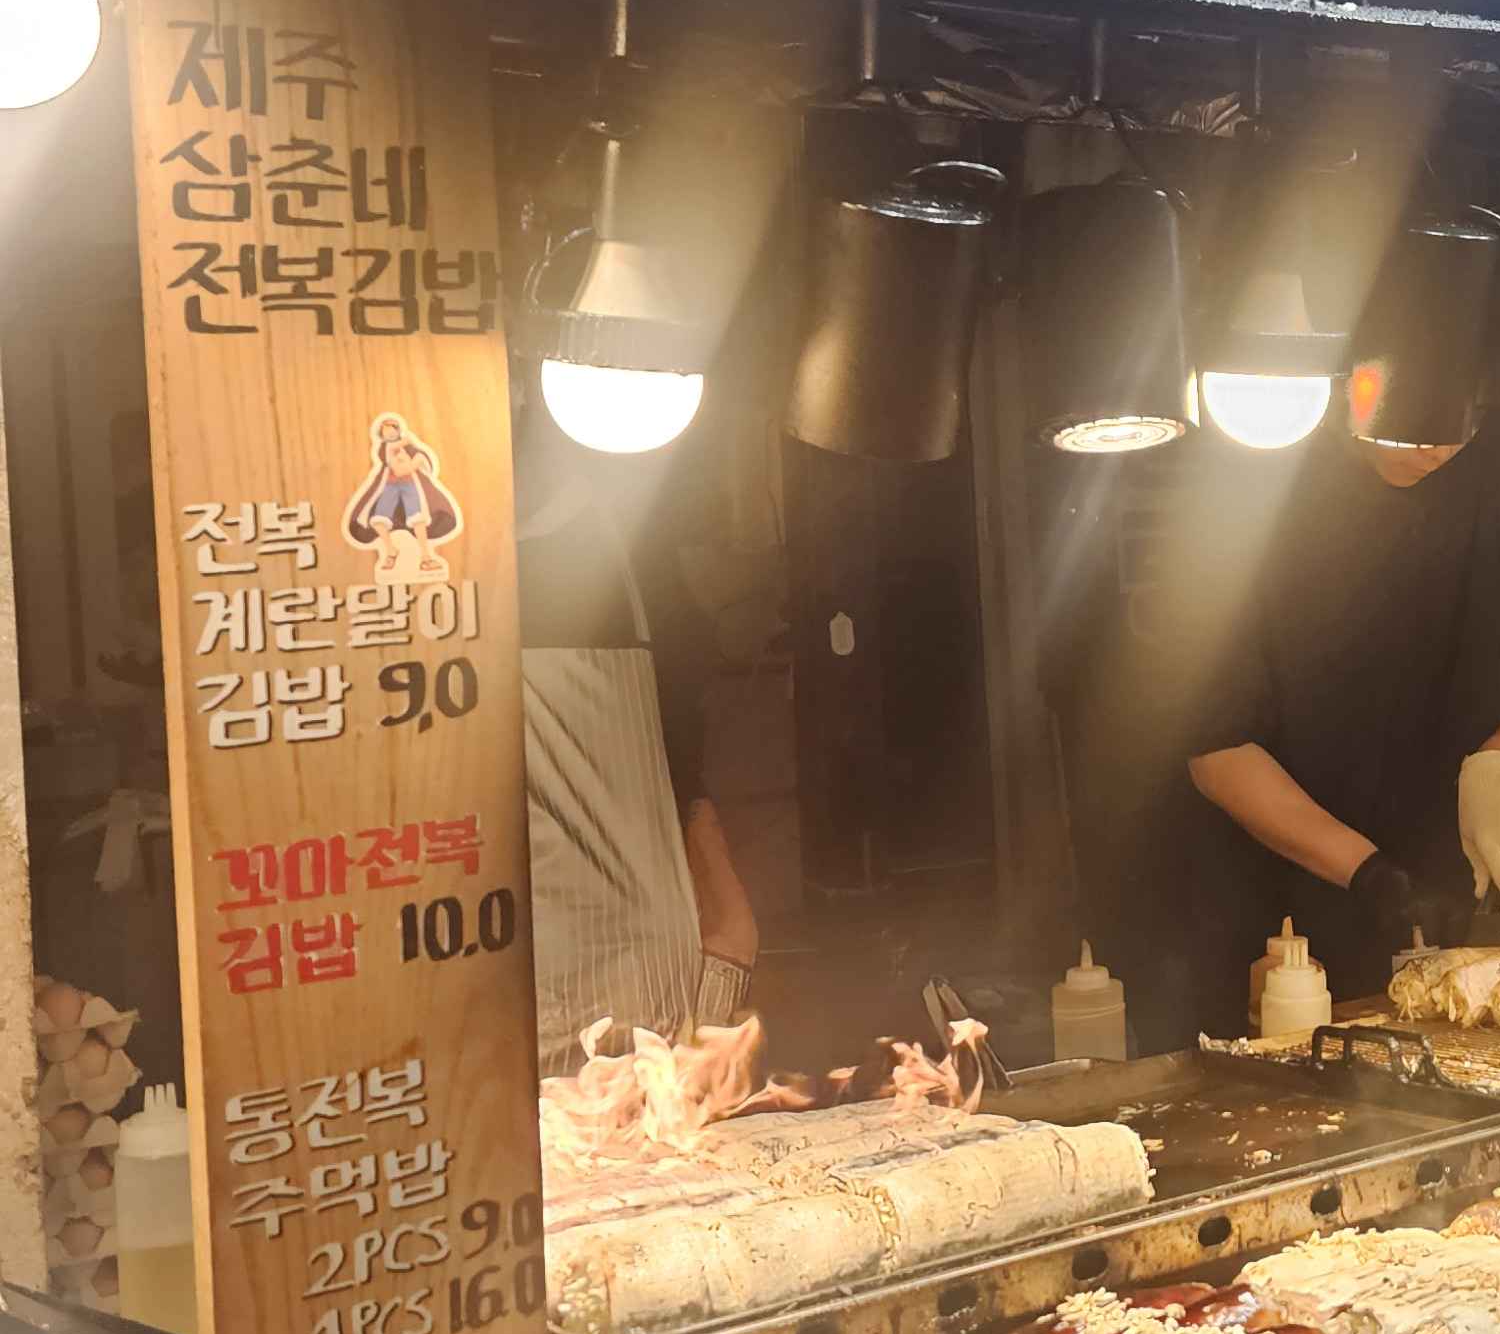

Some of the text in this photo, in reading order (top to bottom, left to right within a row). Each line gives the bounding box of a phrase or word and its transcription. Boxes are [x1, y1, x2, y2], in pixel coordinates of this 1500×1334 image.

[166, 20, 359, 121] 제주
[158, 130, 428, 232] 삼춘네
[166, 240, 502, 336] 전복김밥
[182, 501, 317, 576] 전복
[192, 580, 480, 655] 계란말이
[195, 664, 352, 749] 김밥
[210, 813, 484, 913] 꼬마전복
[217, 913, 364, 996] 김밥
[224, 1058, 428, 1166] 통전복
[229, 1138, 454, 1240] 주먹밥
[302, 1215, 451, 1301] 2PCS
